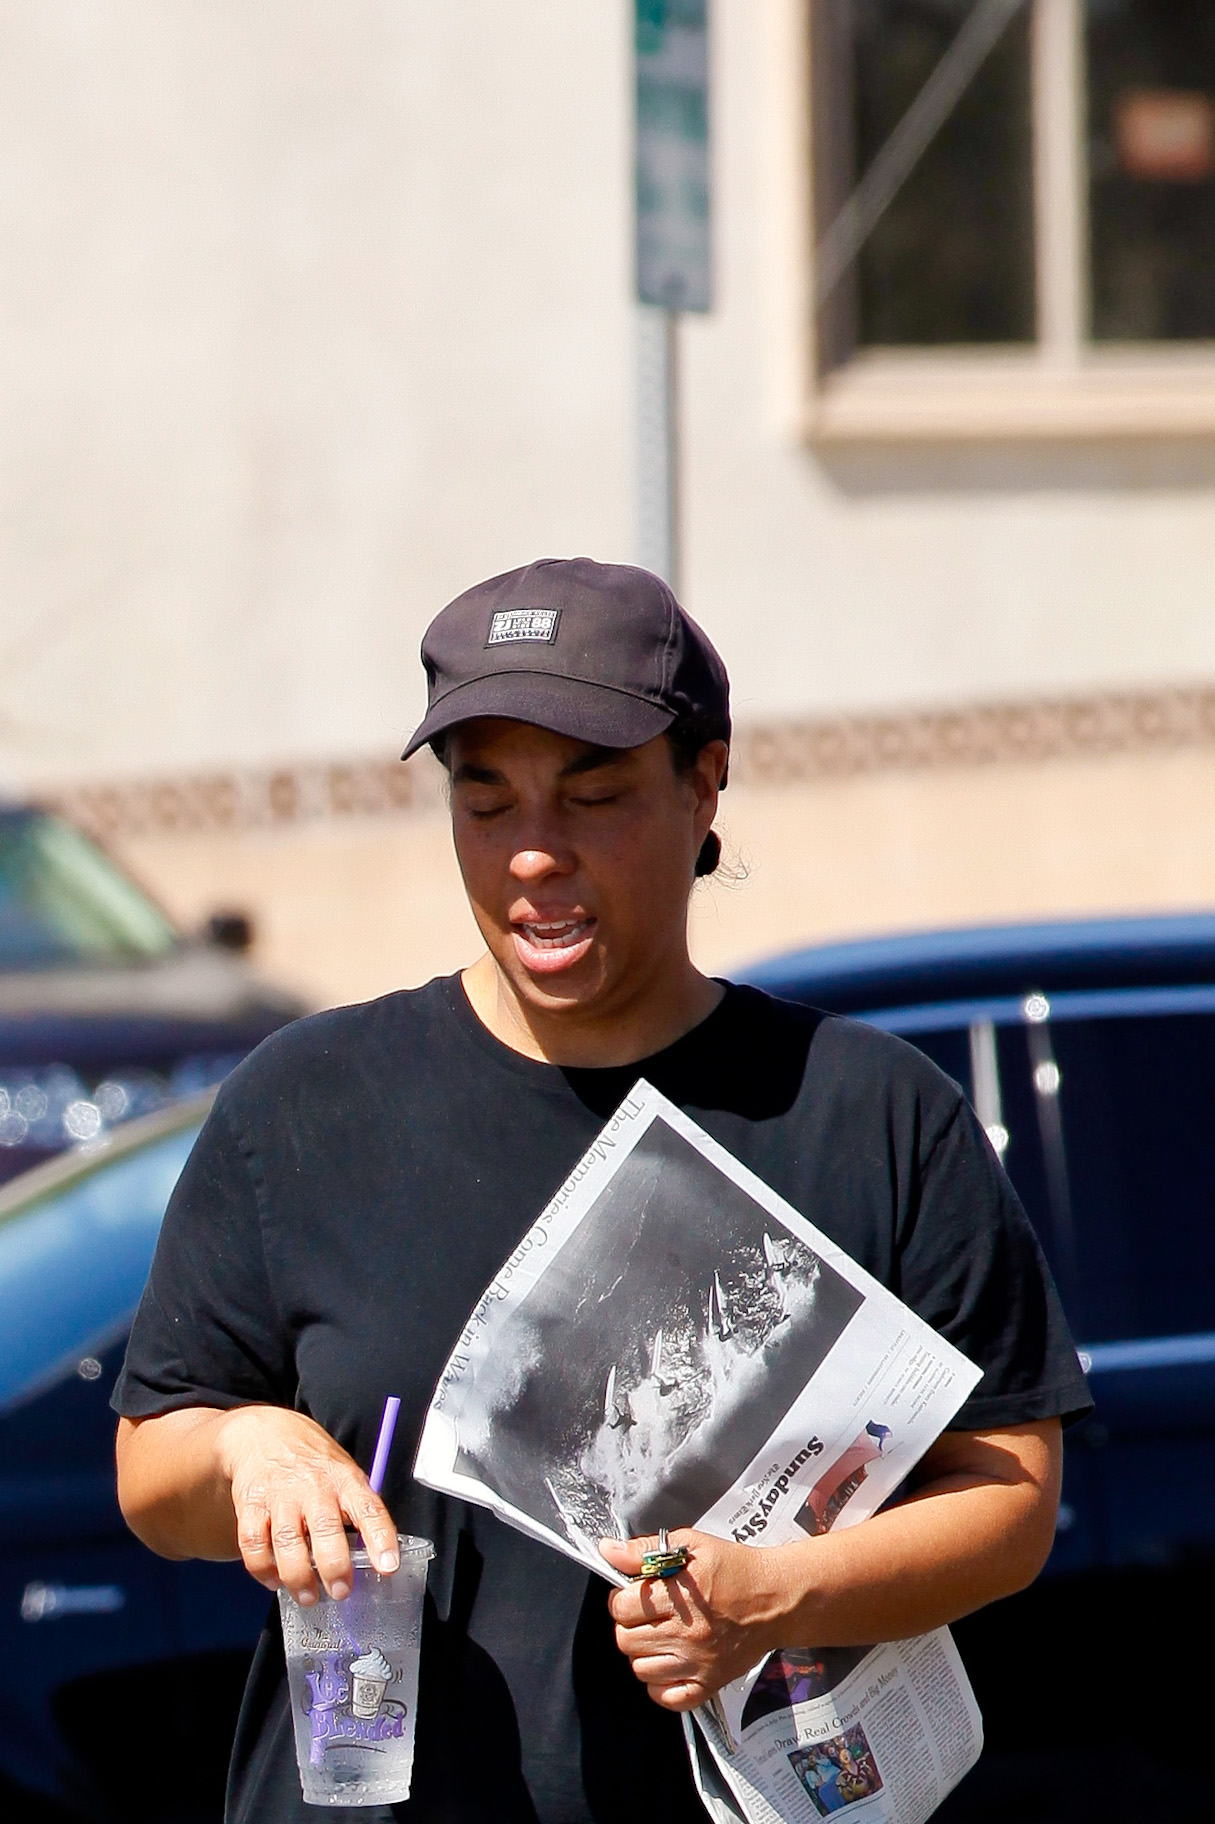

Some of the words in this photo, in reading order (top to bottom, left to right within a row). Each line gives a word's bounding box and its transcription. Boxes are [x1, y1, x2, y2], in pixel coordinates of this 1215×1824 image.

[606, 1095, 645, 1133] The
[541, 1132, 618, 1225] Memories
[501, 1224, 547, 1281] Come
[470, 1280, 510, 1326] Back
[459, 1328, 480, 1347] in
[431, 1354, 470, 1410] Waves
[755, 1474, 771, 1490] New
[765, 1462, 781, 1476] The
[727, 1505, 750, 1525] Times
[744, 1488, 760, 1507] York
[774, 1734, 802, 1751] Draw
[804, 1722, 830, 1740] Real
[832, 1704, 860, 1728] Crowds
